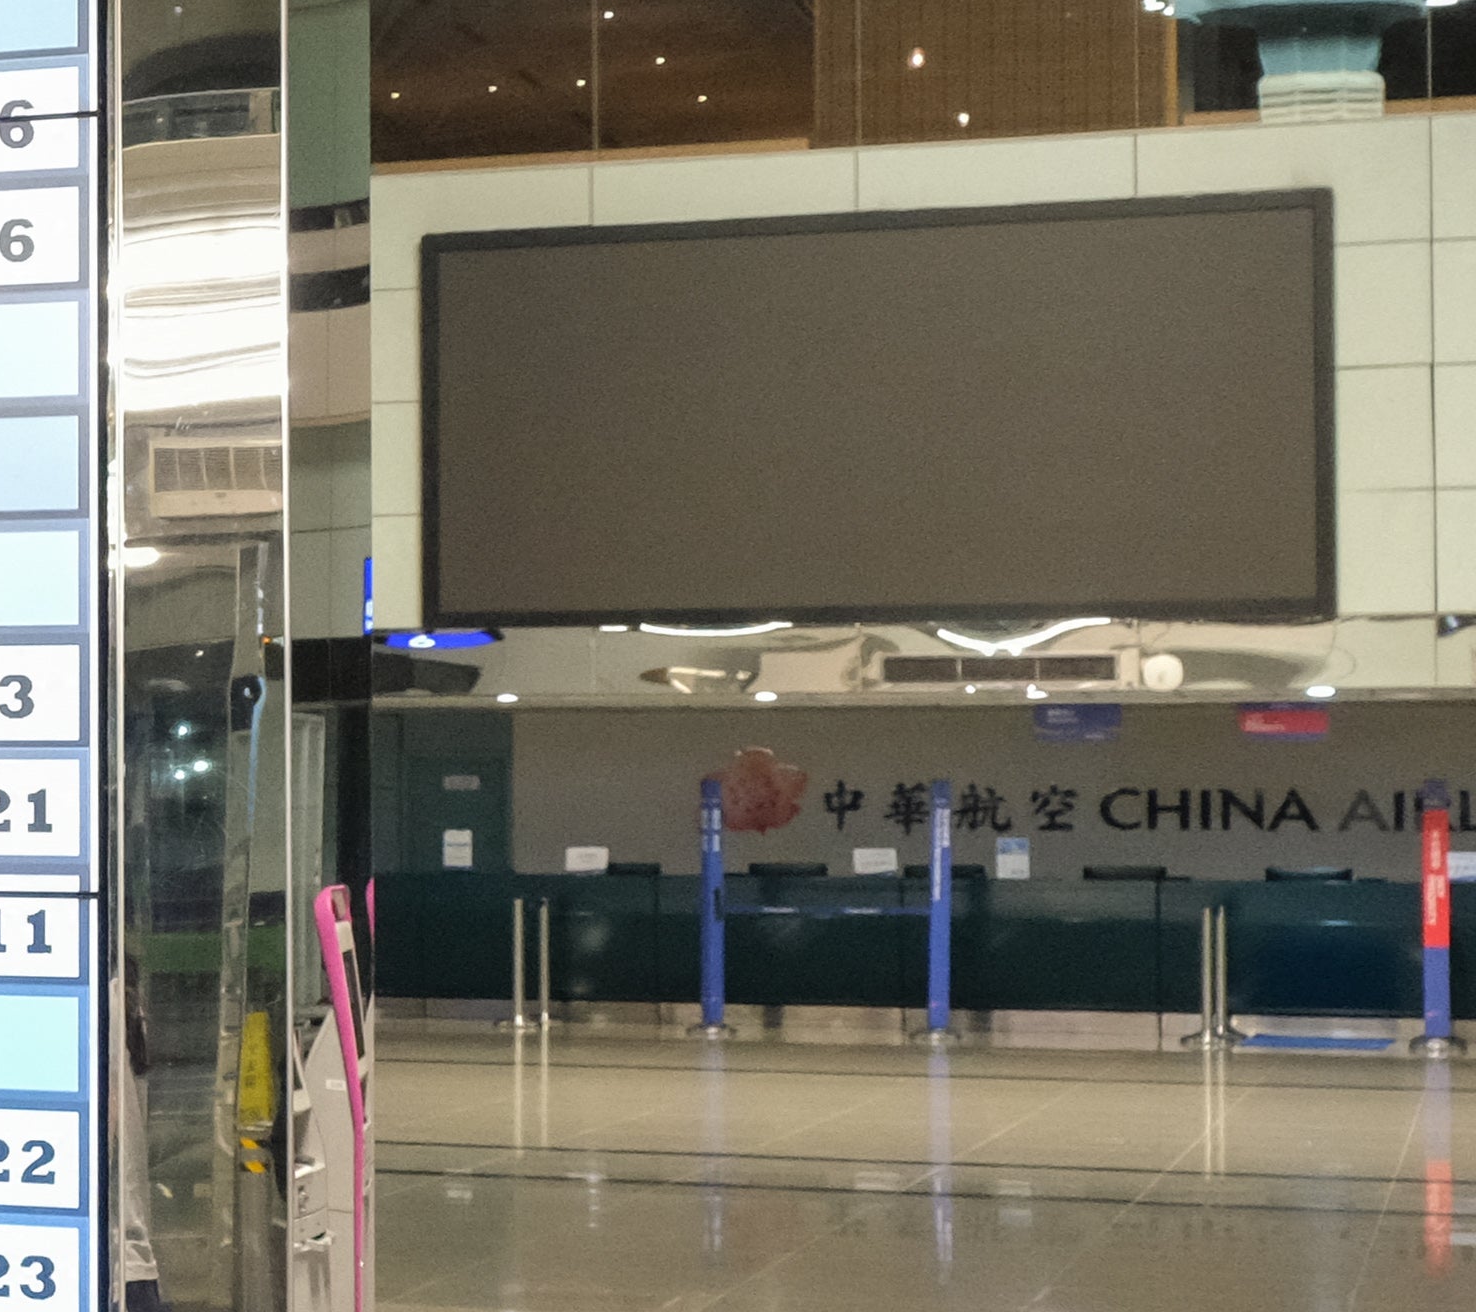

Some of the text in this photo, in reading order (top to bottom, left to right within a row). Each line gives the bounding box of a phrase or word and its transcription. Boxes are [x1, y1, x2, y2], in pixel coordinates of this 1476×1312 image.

[823, 780, 1077, 833] 中華航空
[1100, 787, 1320, 832] CHINA
